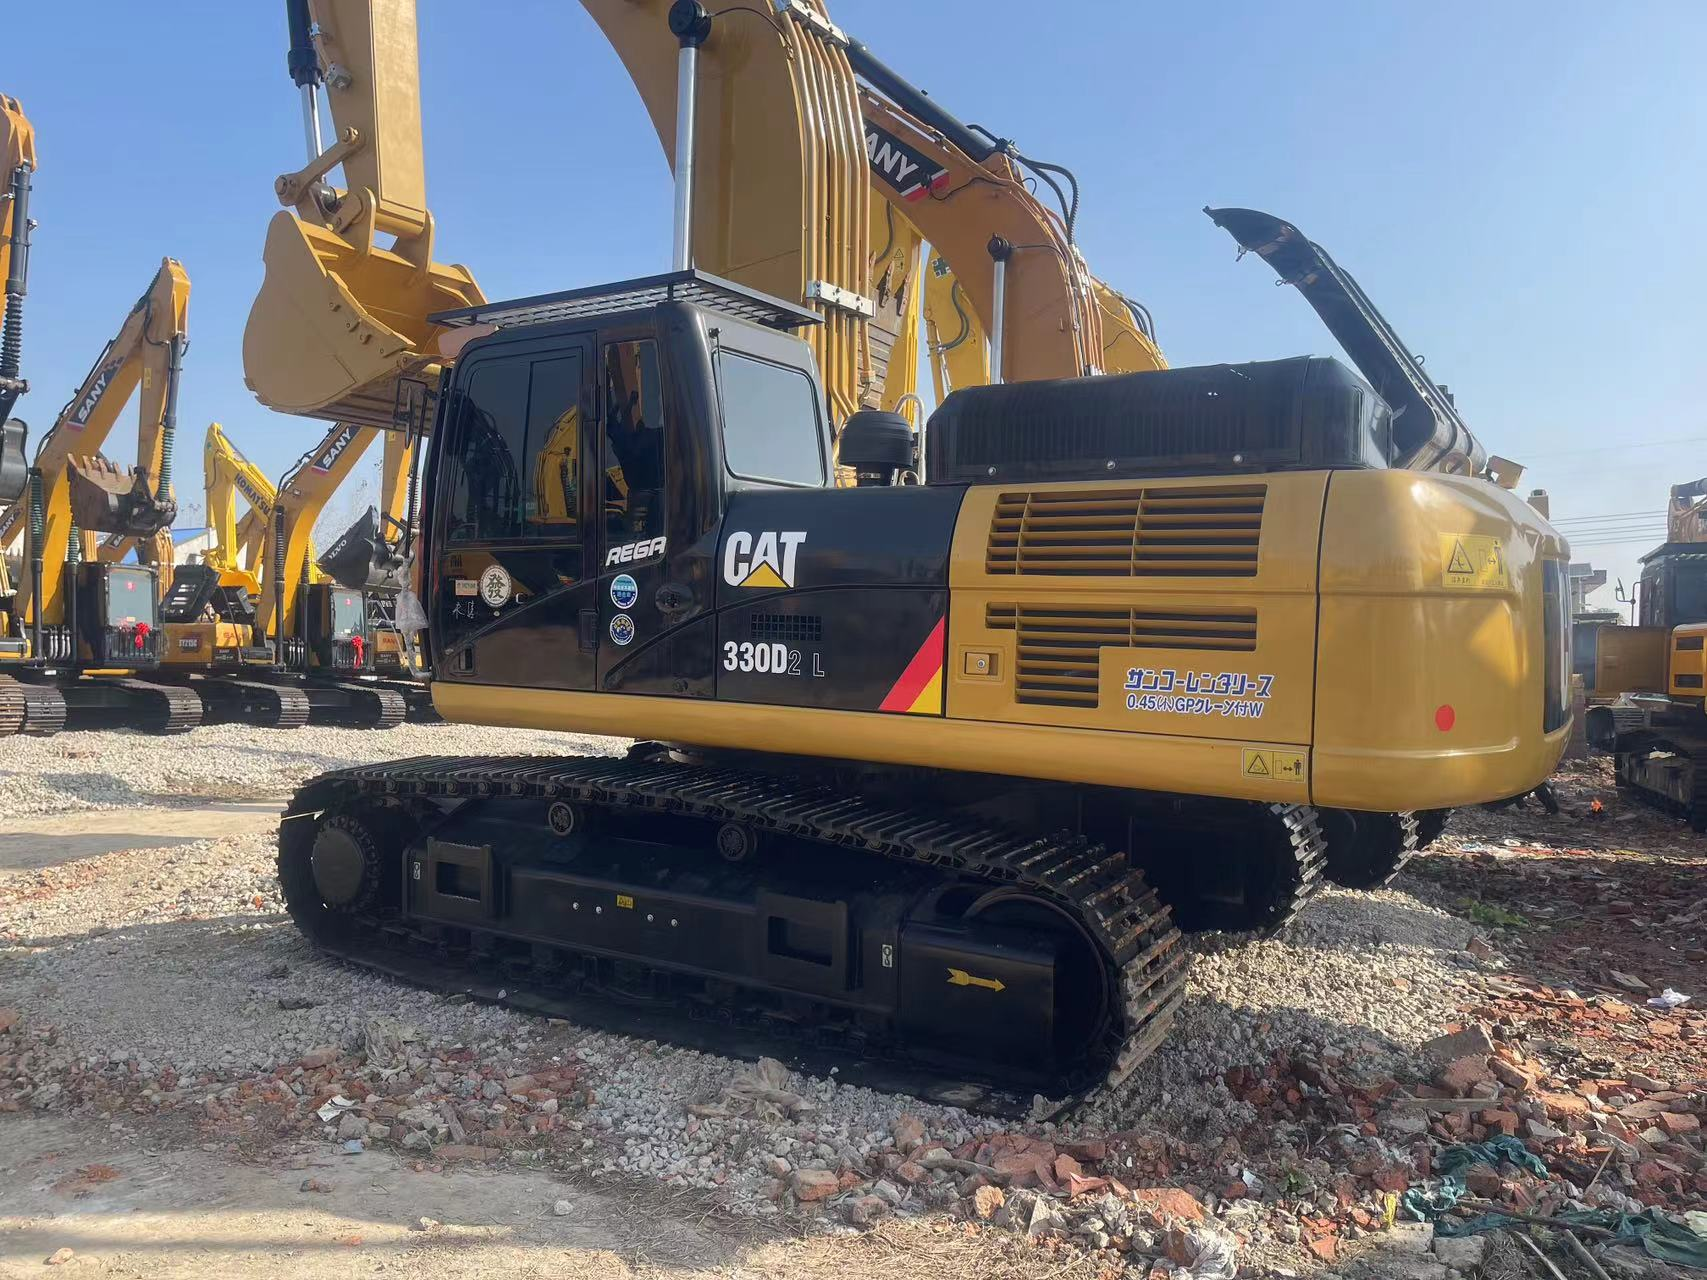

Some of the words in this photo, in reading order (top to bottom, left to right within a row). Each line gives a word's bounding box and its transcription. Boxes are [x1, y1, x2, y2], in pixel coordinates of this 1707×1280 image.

[864, 124, 919, 183] ANY
[78, 373, 107, 423] SANY
[322, 427, 353, 469] SANY
[234, 472, 271, 516] KOMATSU
[605, 536, 667, 566] REGA
[723, 531, 807, 588] CAT
[723, 641, 802, 676] 330D2
[812, 652, 825, 678] L
[1124, 668, 1275, 698] サンコーレンタリース
